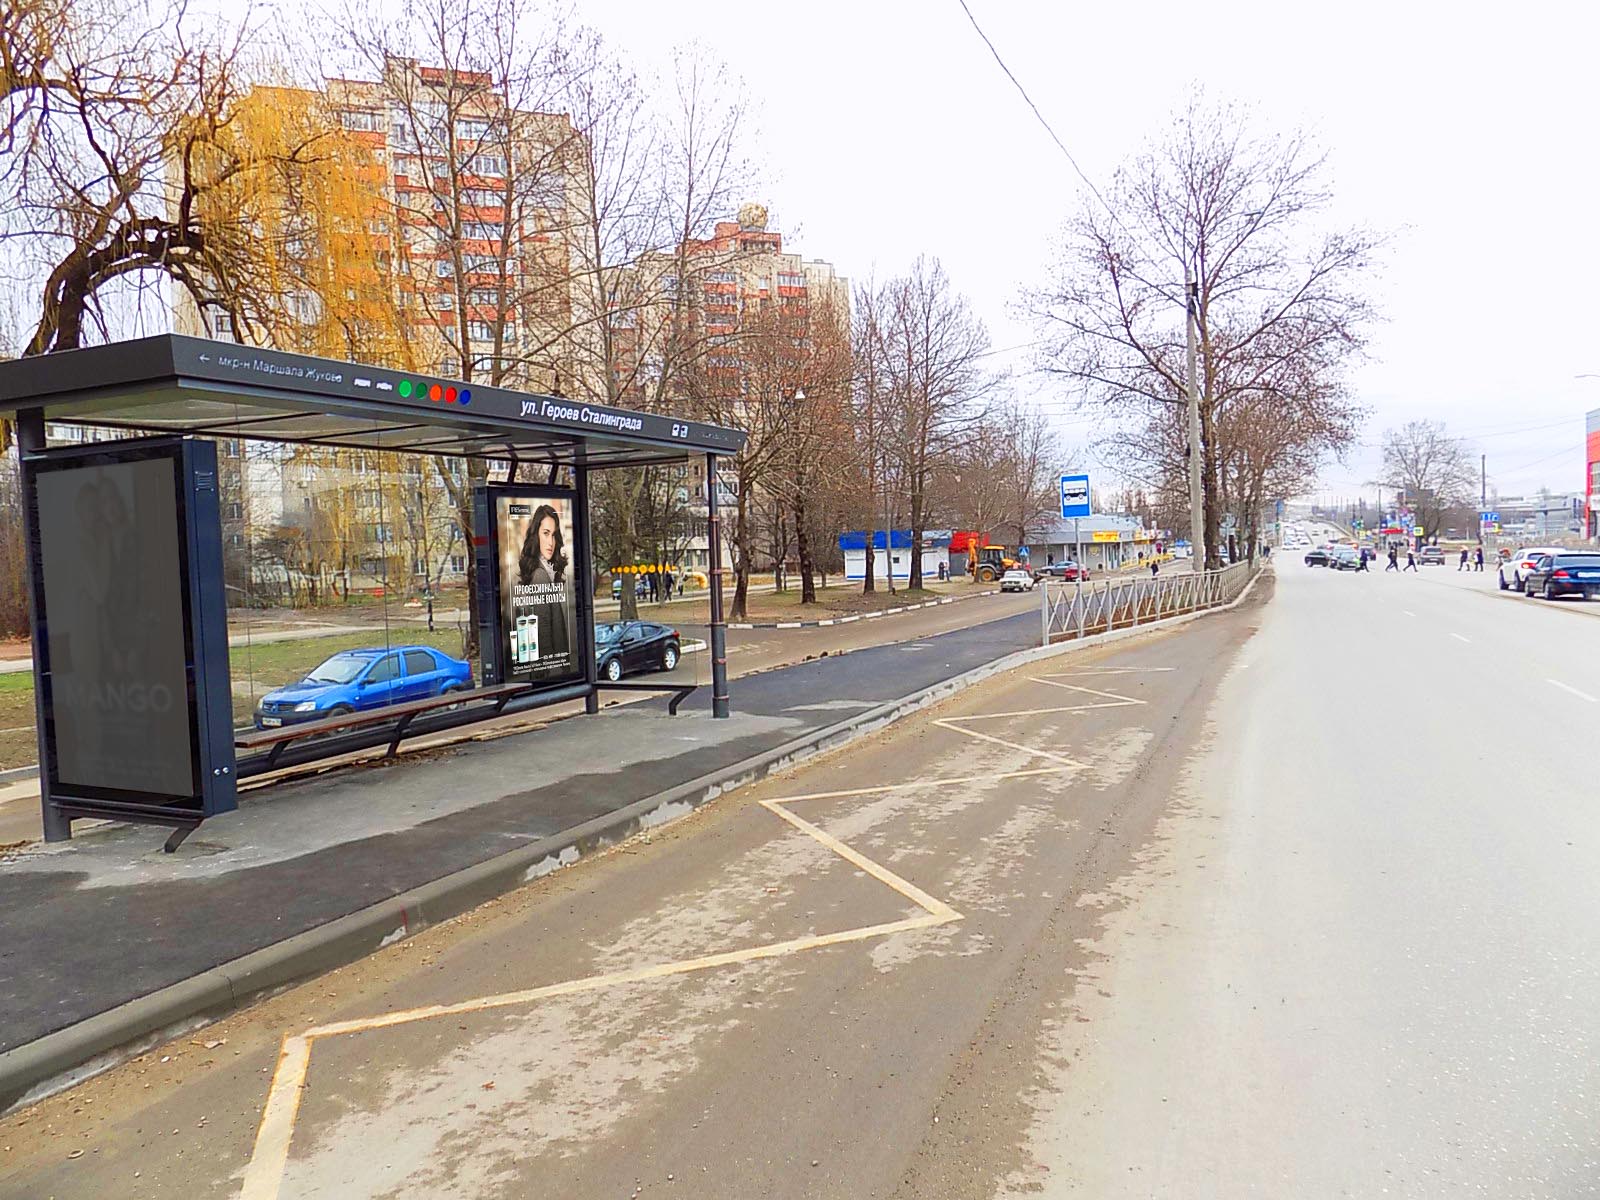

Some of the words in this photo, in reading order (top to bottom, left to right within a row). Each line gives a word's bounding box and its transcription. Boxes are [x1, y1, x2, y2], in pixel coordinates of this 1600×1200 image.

[218, 356, 251, 370] мкр-н
[253, 359, 304, 377] Маршала
[520, 400, 539, 417] ул.
[540, 401, 579, 422] Героев
[580, 408, 642, 431] Сталинграда
[64, 682, 174, 714] MANGO
